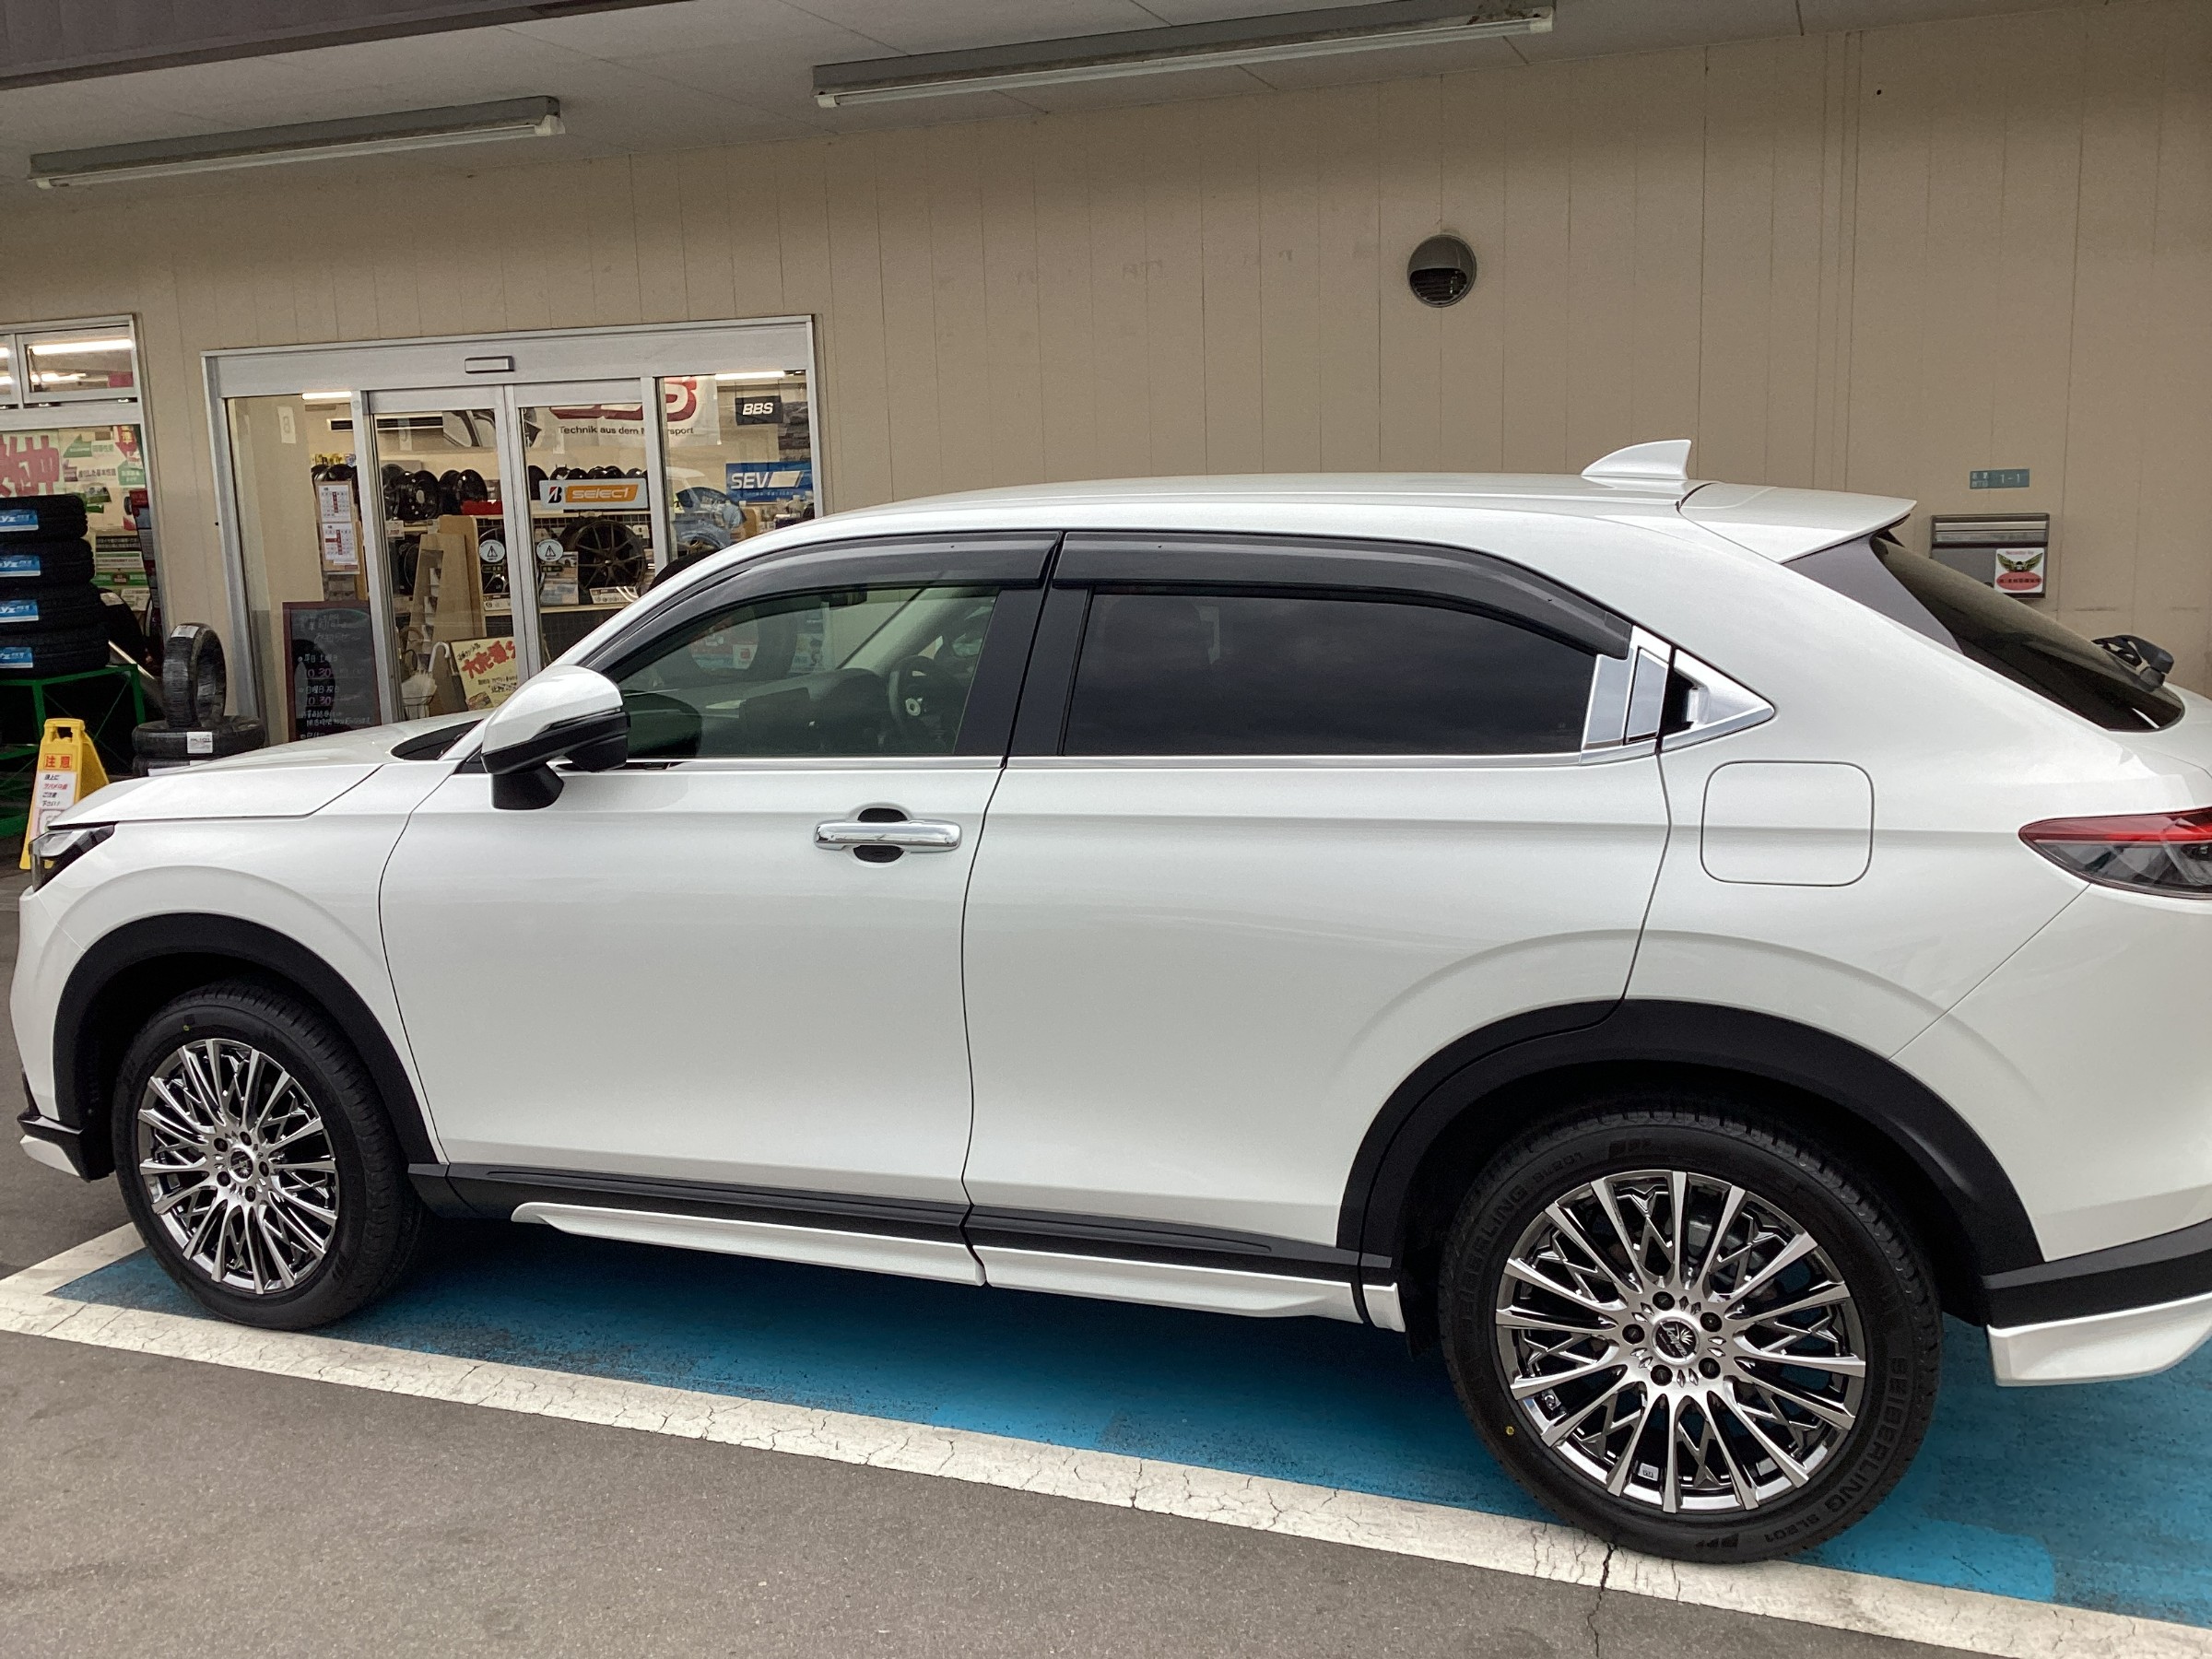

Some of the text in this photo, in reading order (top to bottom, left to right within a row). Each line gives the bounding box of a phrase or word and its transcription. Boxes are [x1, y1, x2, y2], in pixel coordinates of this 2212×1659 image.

[743, 403, 773, 415] BBS
[559, 426, 597, 434] Technik
[731, 471, 770, 489] SEV
[571, 488, 629, 500] select
[45, 755, 71, 769] 注意
